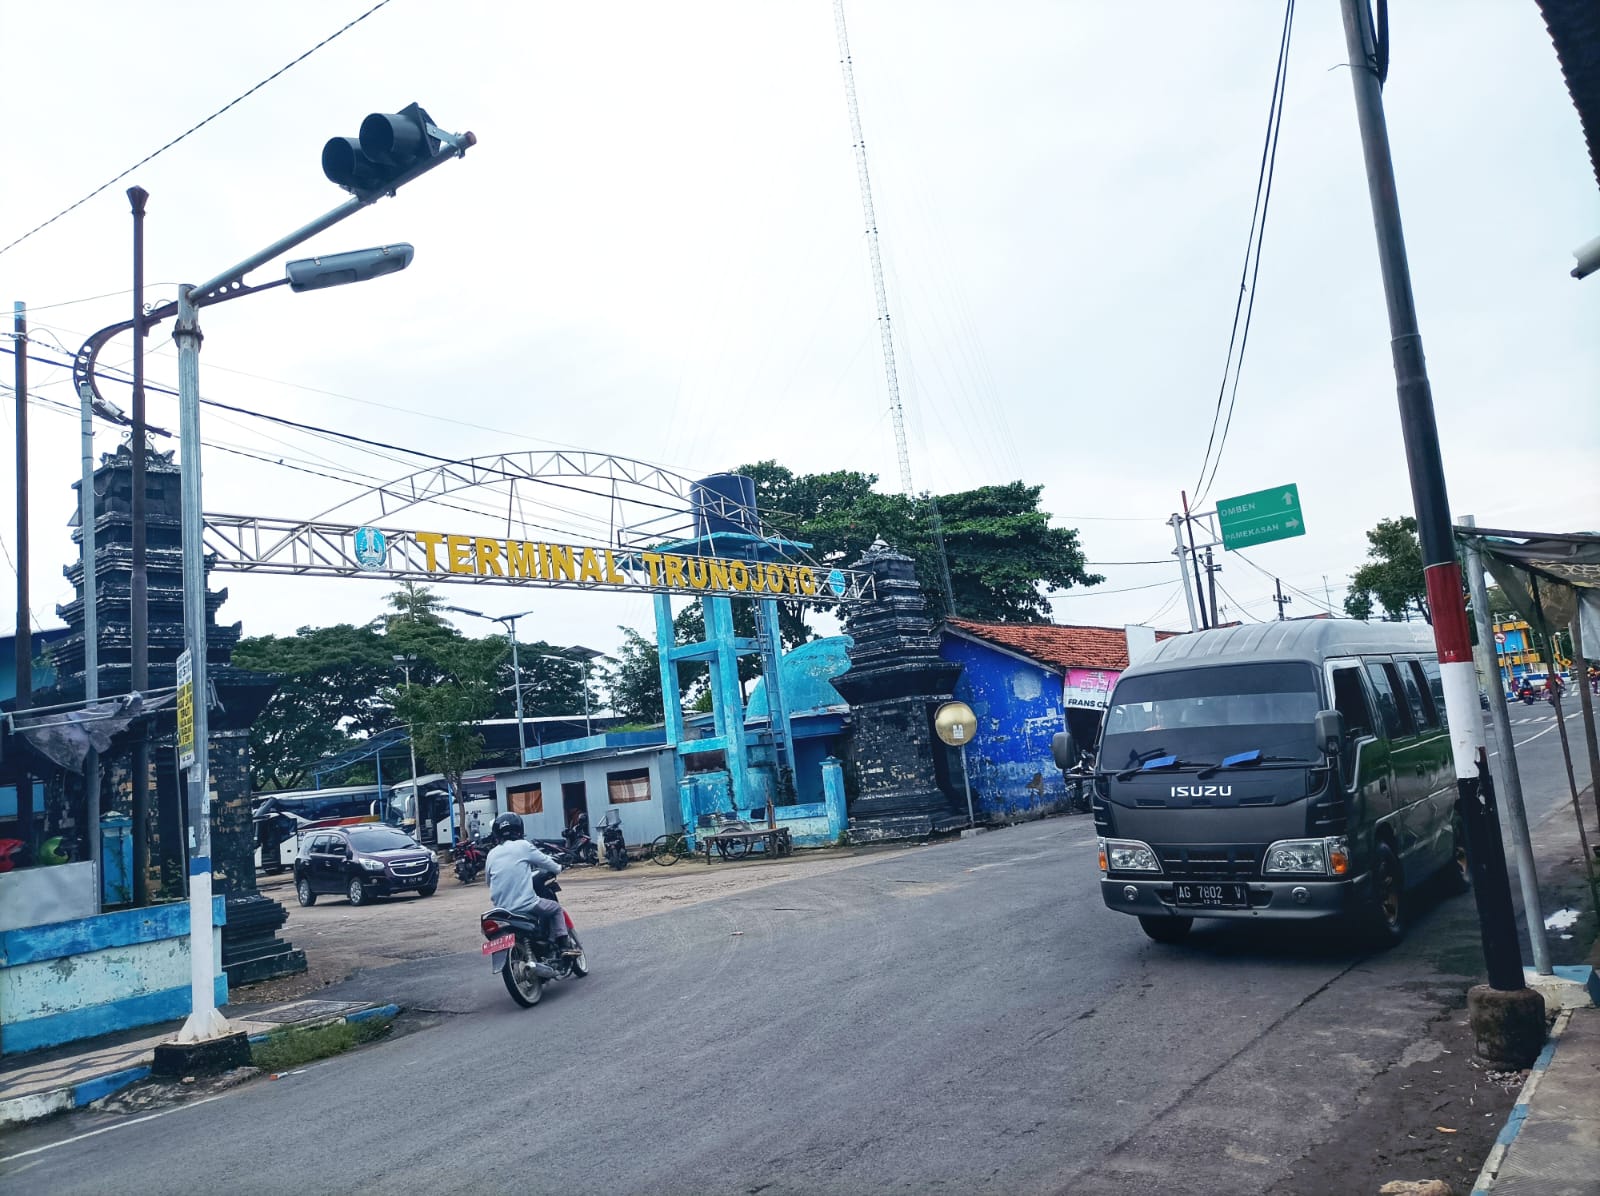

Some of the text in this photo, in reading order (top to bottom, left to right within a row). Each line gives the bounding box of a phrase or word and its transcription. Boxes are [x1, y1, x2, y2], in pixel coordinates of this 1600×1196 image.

[1221, 502, 1256, 517] OMBEN
[1225, 524, 1279, 540] PAMEKASAN
[415, 531, 816, 595] TERMINAL TRUNOJOYO
[1068, 698, 1096, 707] FRANS
[1170, 785, 1232, 798] ISUZU
[1178, 886, 1191, 899] AG
[1196, 886, 1223, 899] 7802
